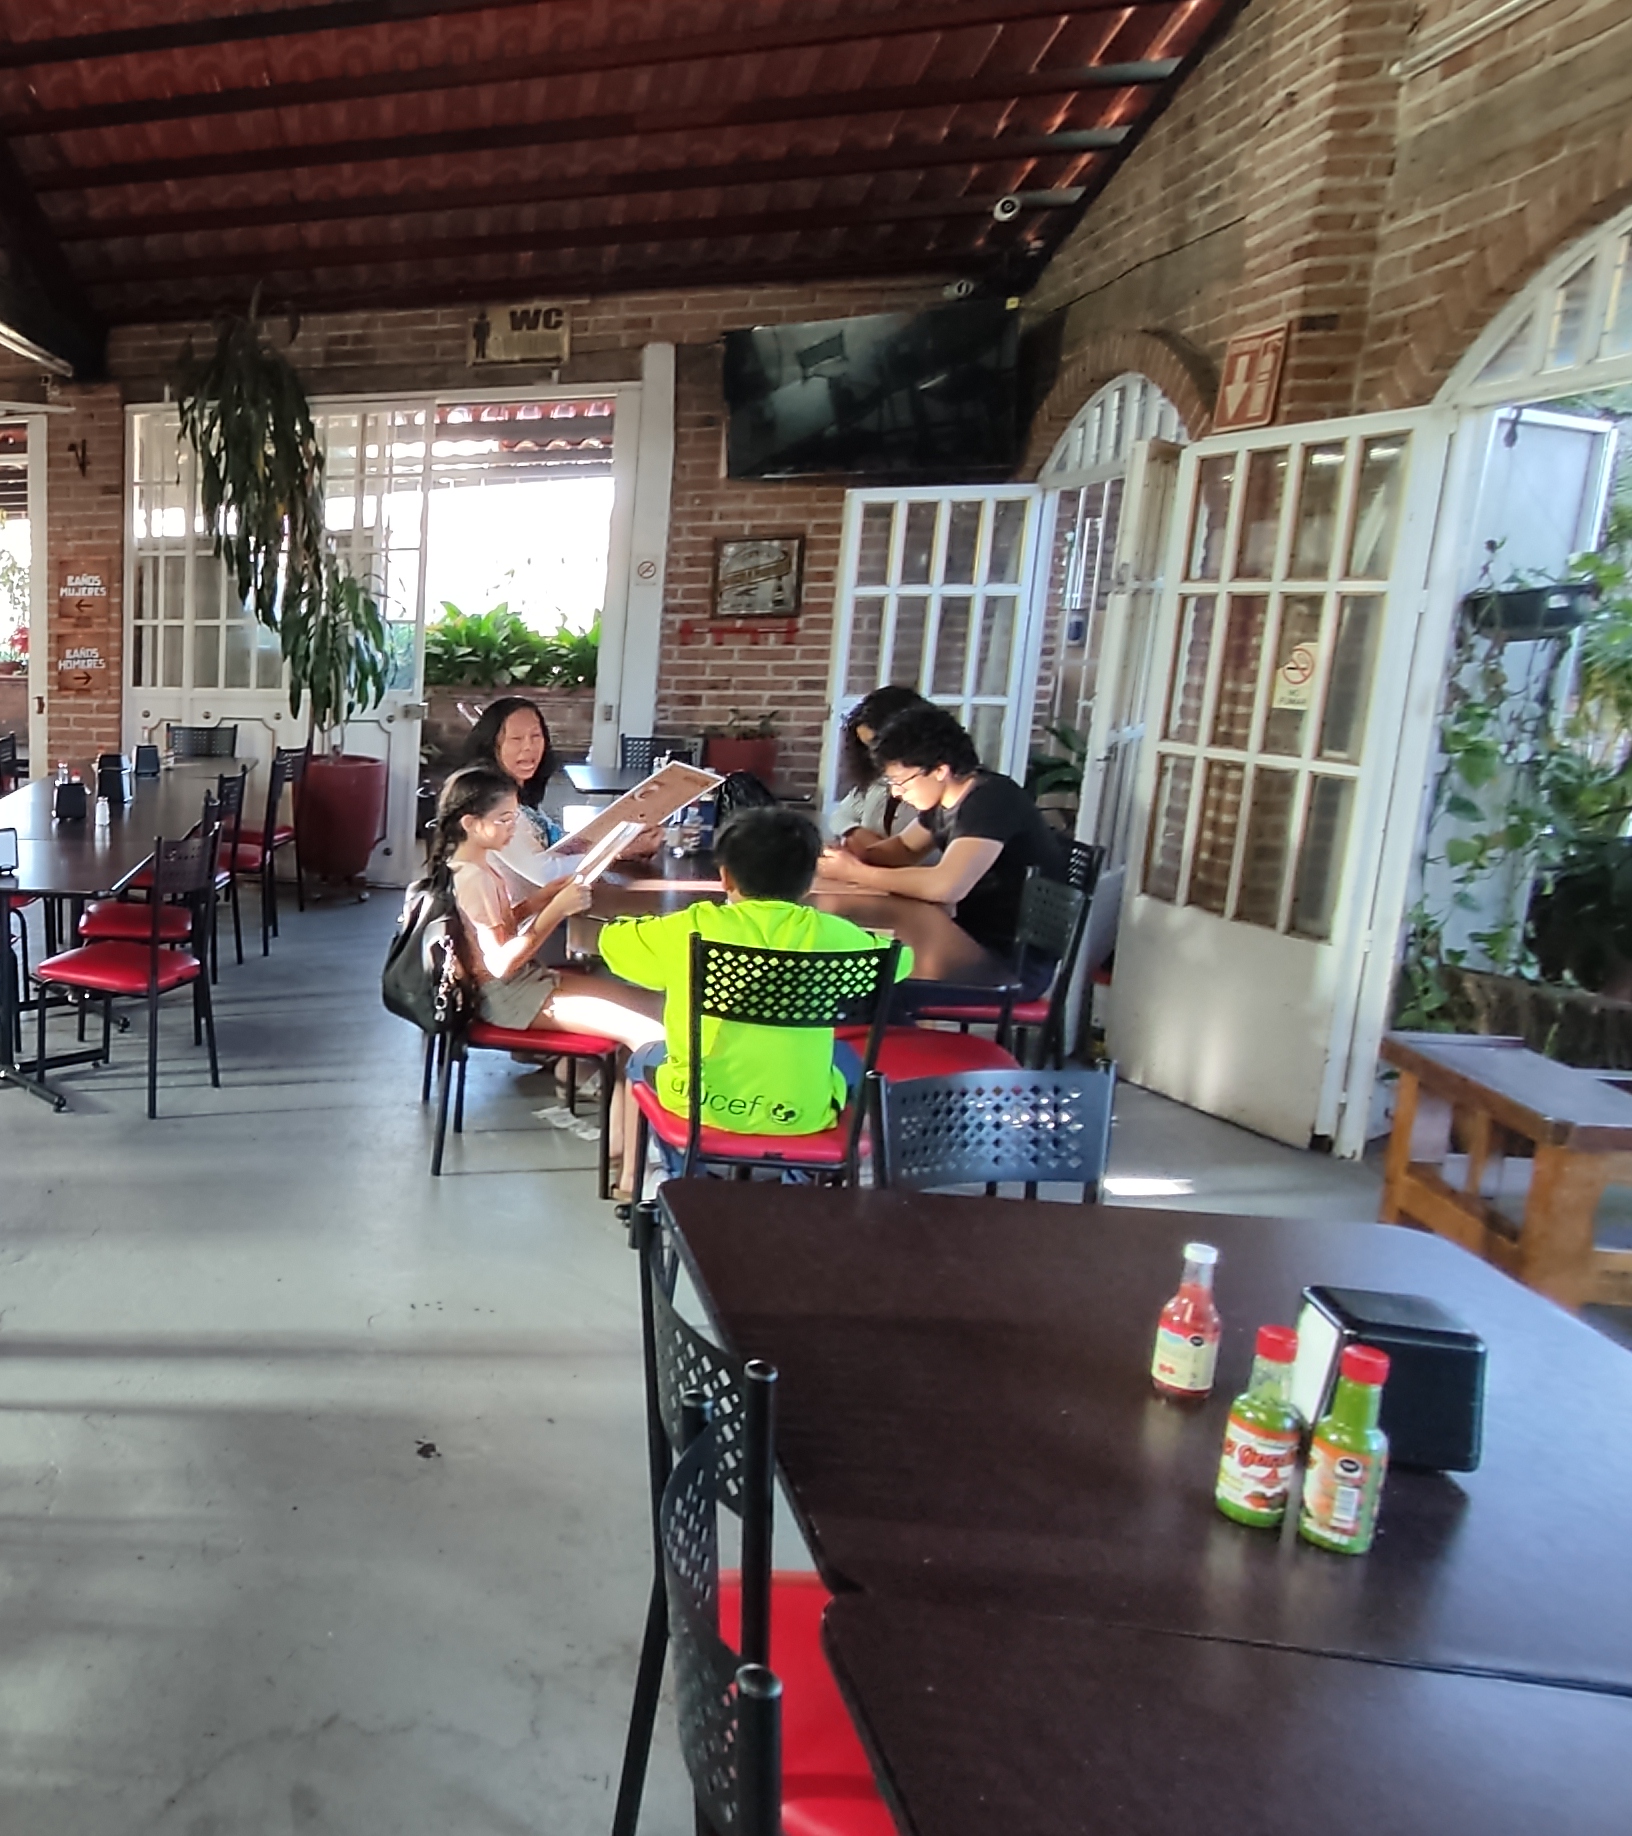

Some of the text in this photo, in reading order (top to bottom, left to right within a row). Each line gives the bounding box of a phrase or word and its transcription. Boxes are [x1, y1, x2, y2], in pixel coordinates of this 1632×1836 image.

[510, 308, 563, 331] WC
[67, 573, 101, 586] BAÑOS
[59, 586, 106, 597] MUJERES
[65, 647, 99, 659] BAÑOS
[58, 659, 106, 670] HOMBRES
[671, 1077, 764, 1117] uicef
